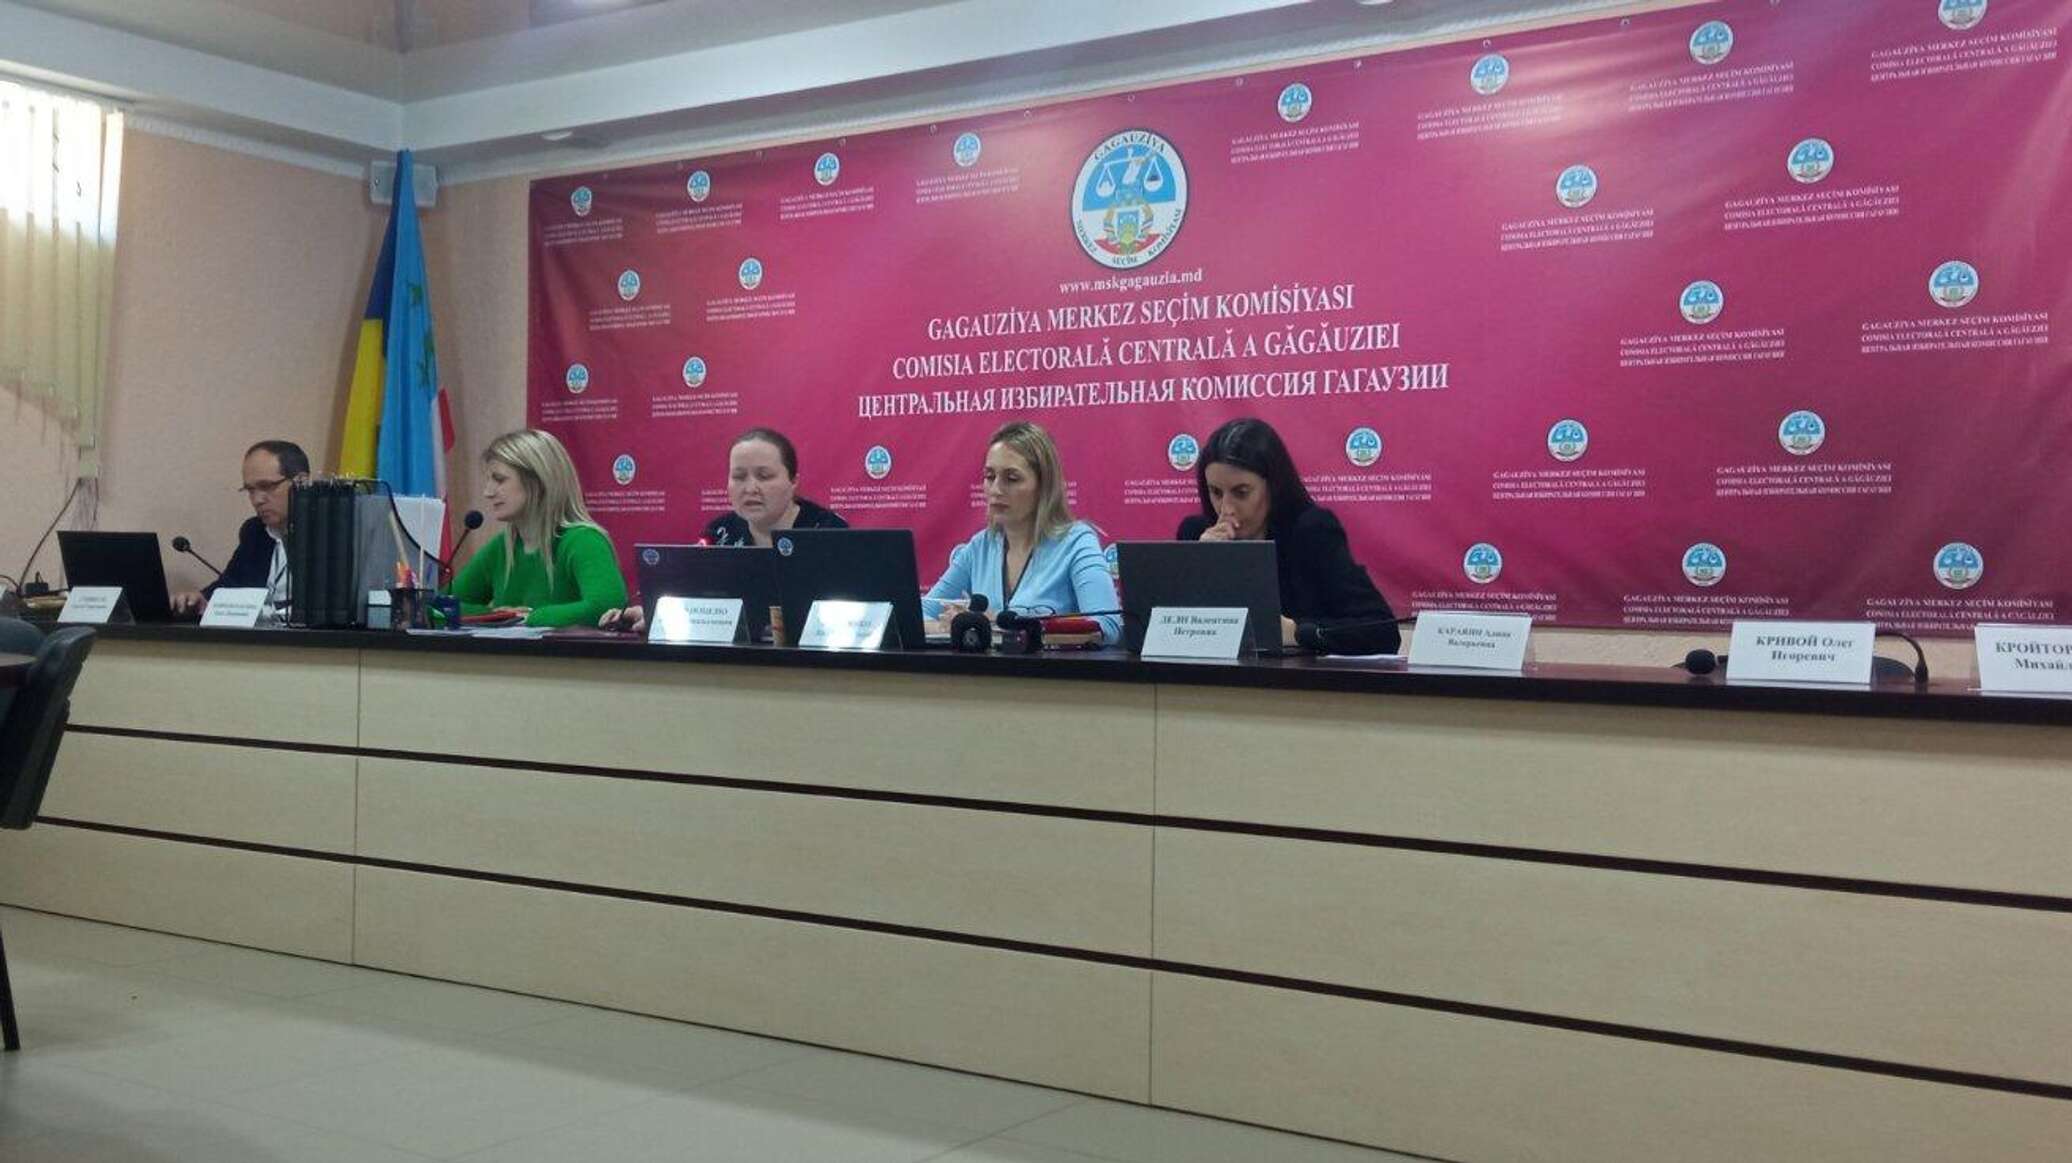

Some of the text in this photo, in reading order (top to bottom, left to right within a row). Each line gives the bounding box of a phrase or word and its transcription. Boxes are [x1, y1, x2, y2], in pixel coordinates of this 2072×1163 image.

[1059, 268, 1203, 294] www.mskgagauzia.md
[928, 284, 1355, 341] GAGAUZİYA MERKEZ SEÇİM KOMİSİYASI
[892, 322, 1401, 380] COMISIA ELECTORALĂ CENTRALĂ A GĂGĂUZIEI
[858, 363, 1450, 420] ЦЕНТРАЛЬНАЯ ИЗБИРАТЕЛЬНАЯ КОМИССИЯ ГАГАУЗИИ
[1756, 635, 1853, 649] КРИВОЙ Олег
[1771, 650, 1835, 662] Игоревич
